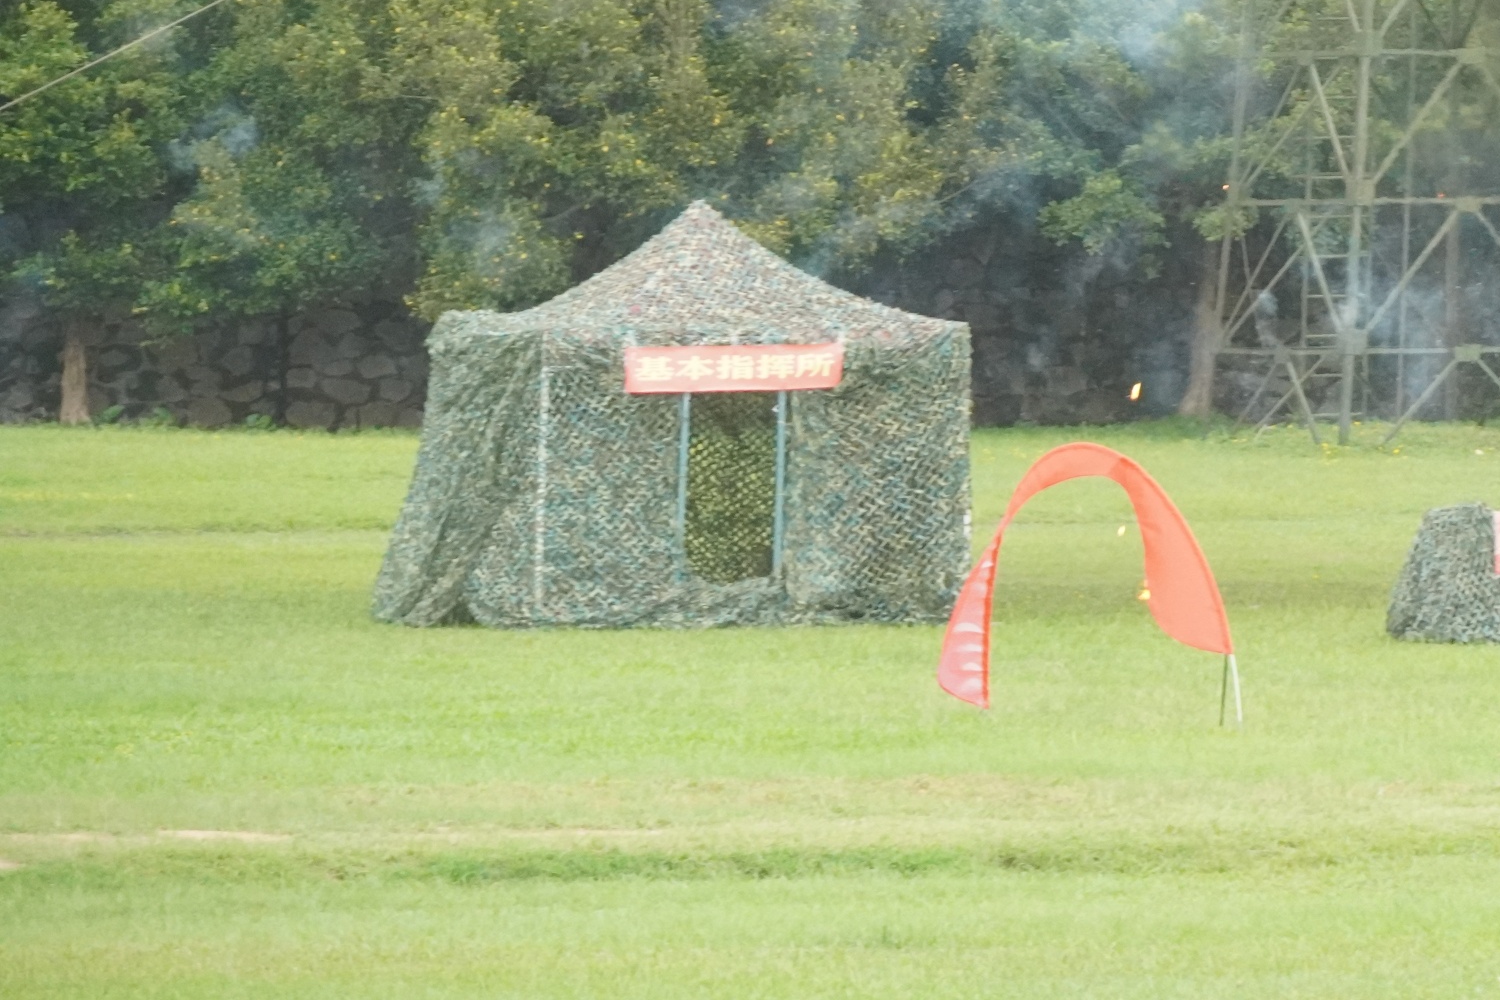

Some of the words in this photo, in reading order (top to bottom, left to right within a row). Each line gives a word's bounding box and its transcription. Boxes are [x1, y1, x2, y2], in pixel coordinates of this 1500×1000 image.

[634, 352, 836, 382] 基本指挥所
